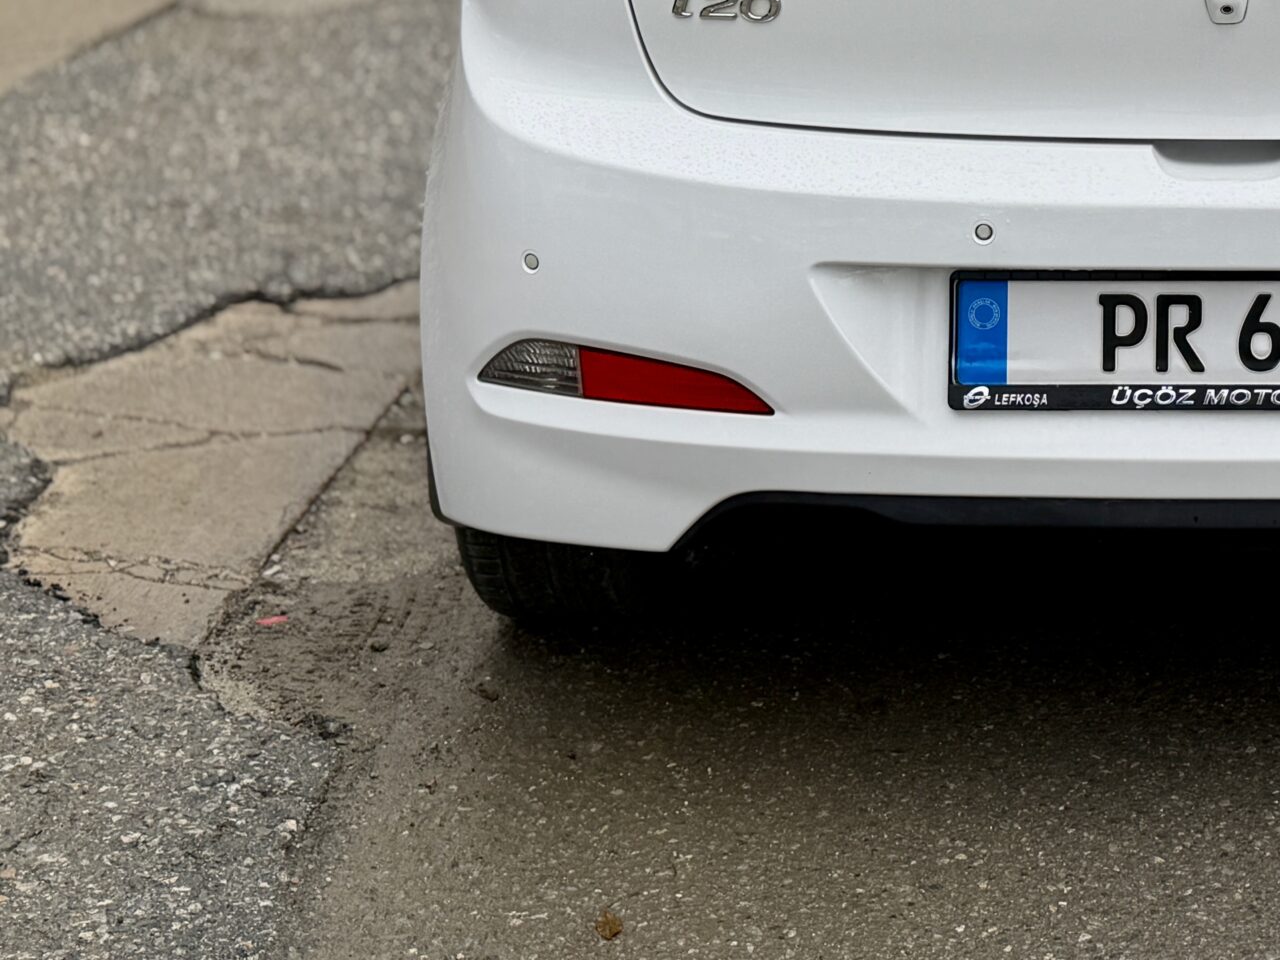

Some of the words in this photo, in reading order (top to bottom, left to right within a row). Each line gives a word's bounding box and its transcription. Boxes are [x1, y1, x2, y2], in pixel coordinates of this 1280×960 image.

[1098, 293, 1206, 373] PR
[994, 393, 1048, 408] LEFKOŞA
[1110, 386, 1197, 409] ÜÇÖZ
